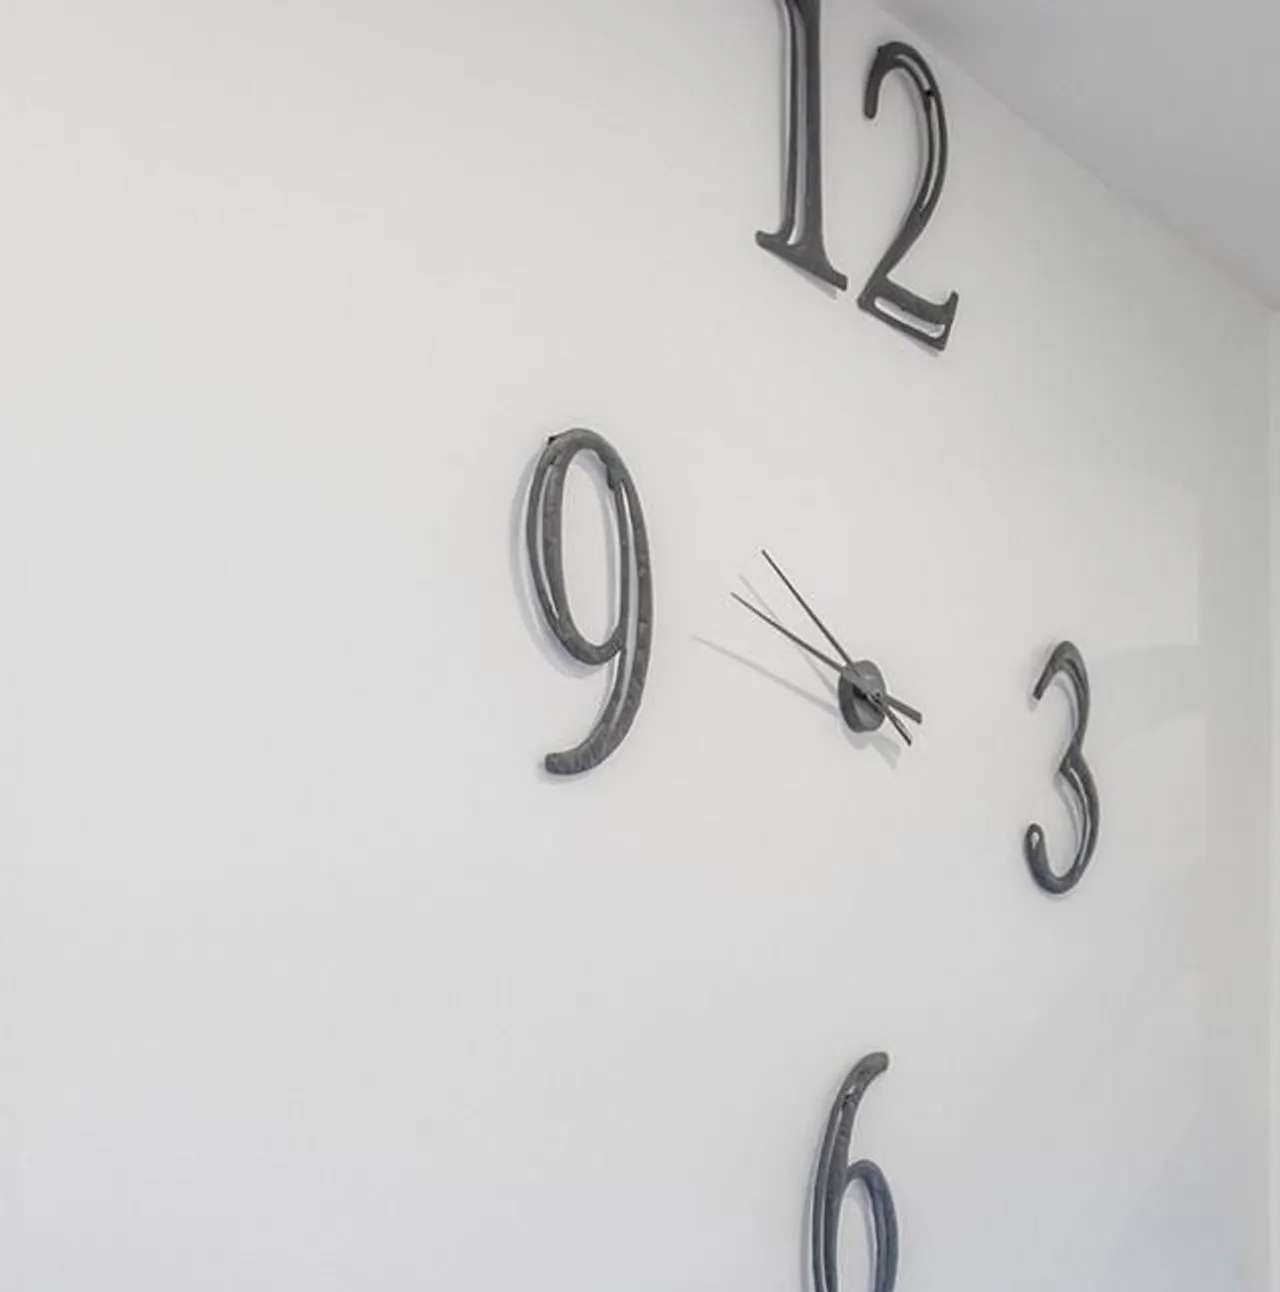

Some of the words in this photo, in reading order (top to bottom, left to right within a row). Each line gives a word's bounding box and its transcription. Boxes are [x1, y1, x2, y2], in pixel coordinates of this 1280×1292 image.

[756, 0, 959, 351] 12
[526, 427, 654, 776] 9
[1024, 640, 1100, 894] 3
